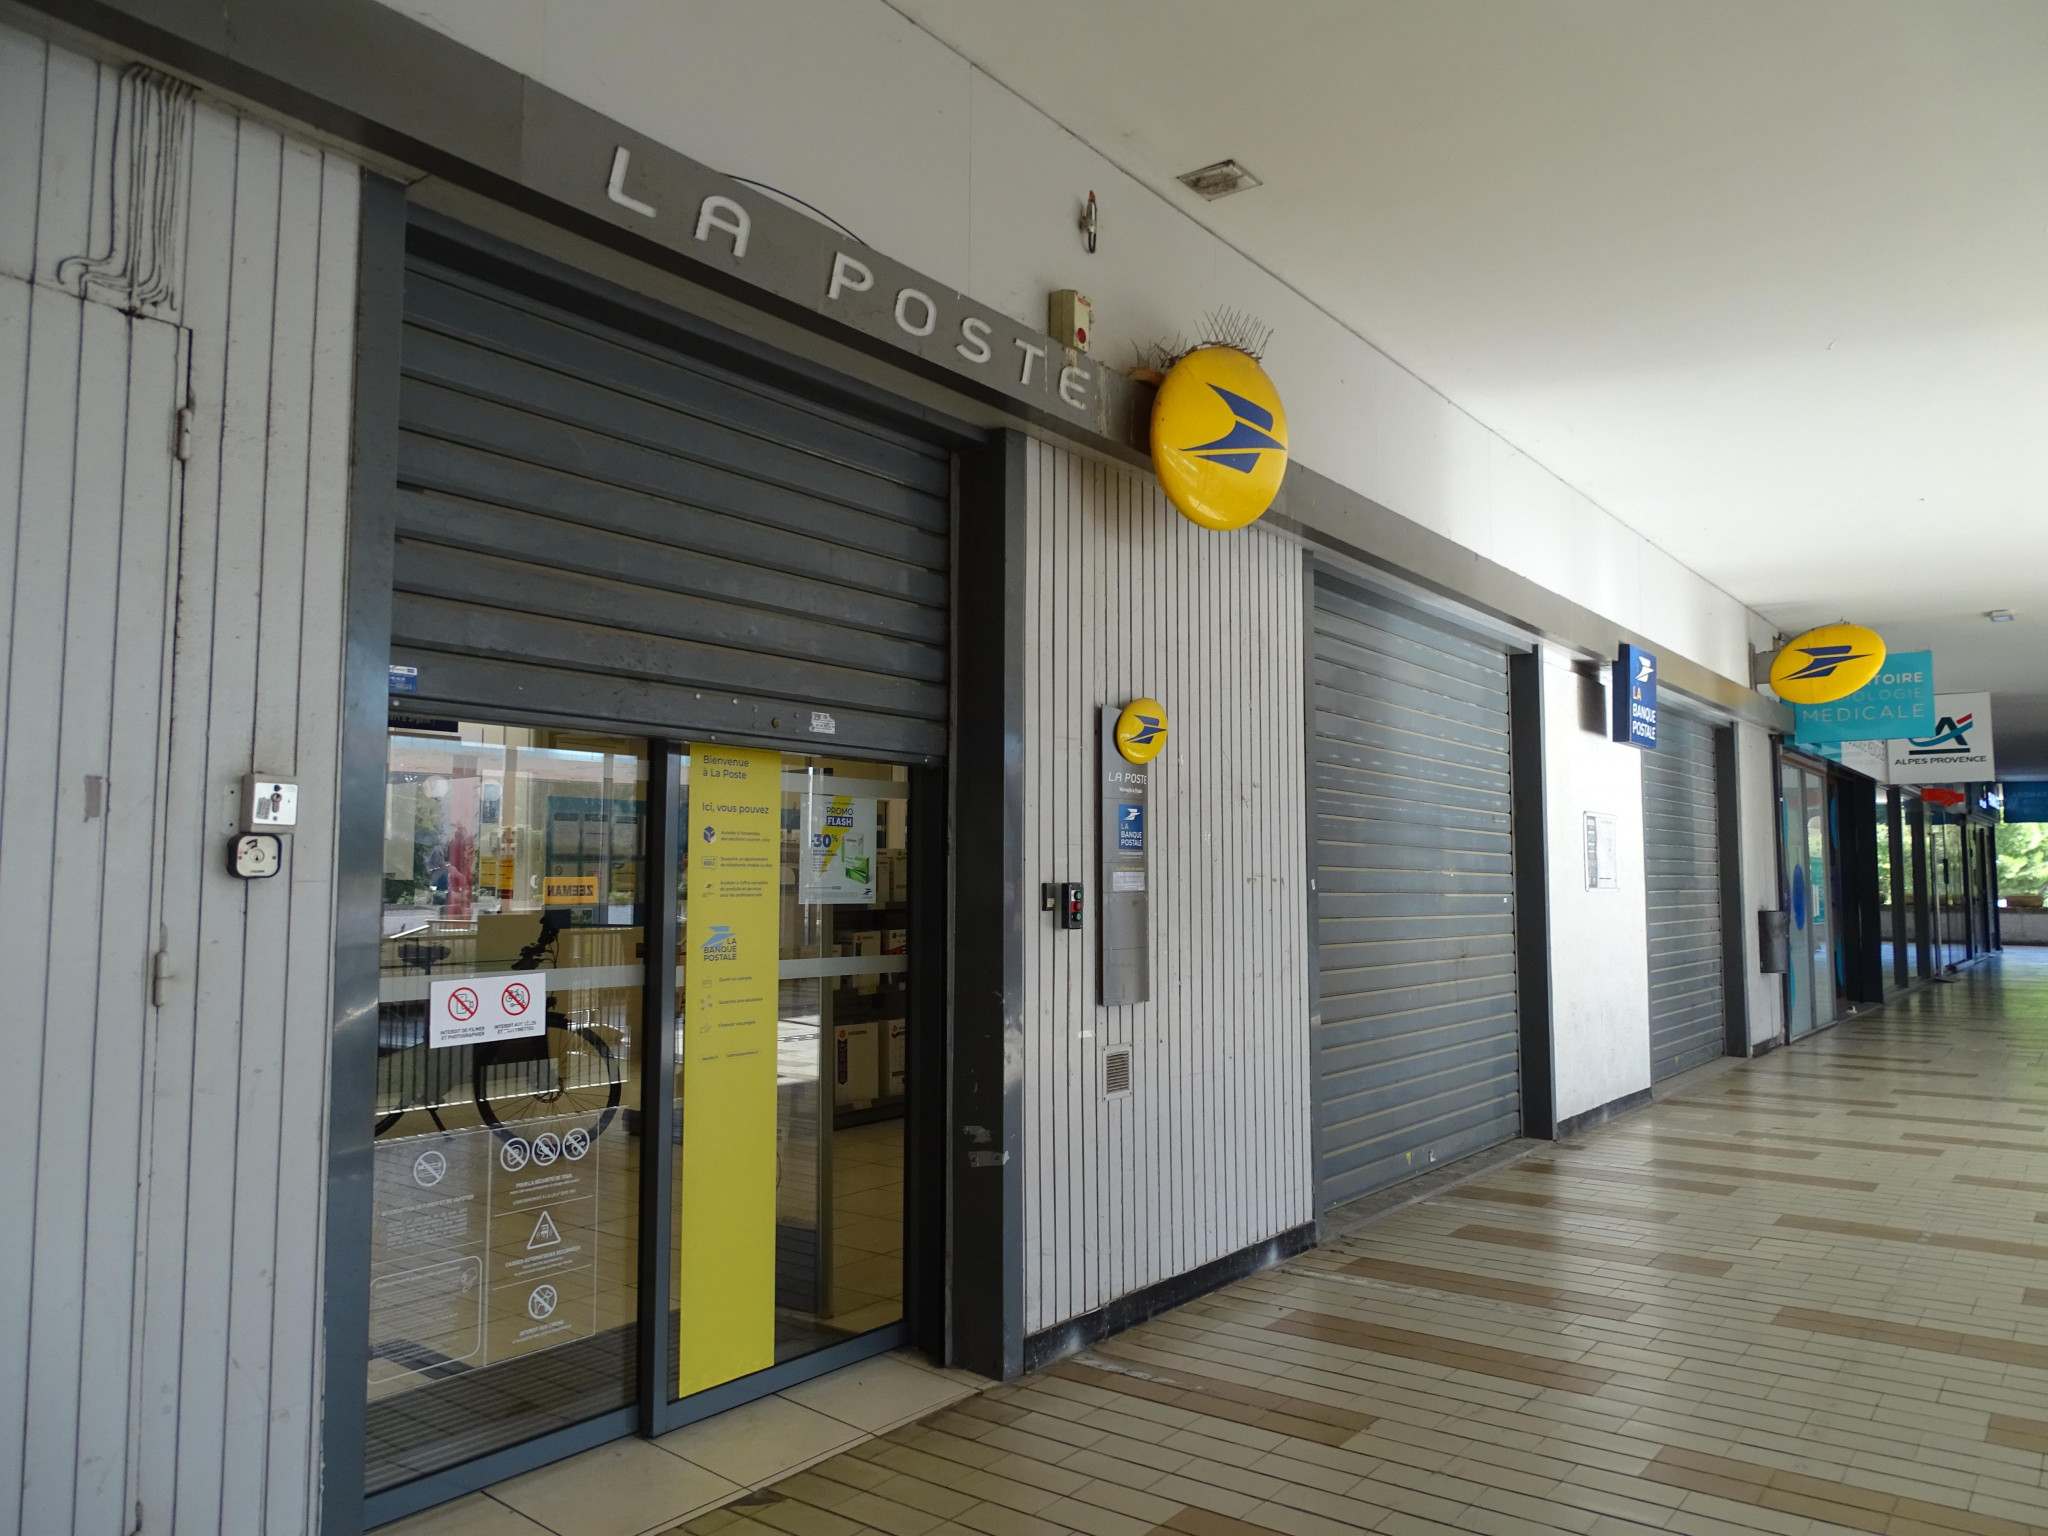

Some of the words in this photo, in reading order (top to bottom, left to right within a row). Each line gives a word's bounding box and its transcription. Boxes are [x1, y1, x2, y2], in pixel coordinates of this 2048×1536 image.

[607, 146, 752, 258] LA
[828, 252, 1092, 410] POSTE
[1632, 685, 1642, 701] LA
[1632, 703, 1656, 724] BANQUE
[1803, 703, 1925, 723] MEDICALE
[1632, 720, 1656, 740] POSTALE
[703, 755, 749, 768] Bienvenue
[1894, 757, 1928, 766] ALPES
[1930, 755, 1987, 764] PROVENCE
[702, 769, 708, 777] à
[710, 769, 721, 778] La
[723, 769, 747, 780] Poste
[1108, 772, 1122, 782] LA
[1124, 773, 1147, 785] POSTE
[702, 802, 715, 812] Ici,
[716, 804, 737, 813] vous
[738, 805, 770, 816] pouvez
[826, 807, 853, 815] PROMO
[828, 817, 851, 826] FLASH
[1120, 831, 1142, 839] BANQUE
[1120, 839, 1142, 847] POSTALE
[704, 946, 737, 954] BANQUE
[448, 1031, 485, 1040] PHOTOGRAPHIER
